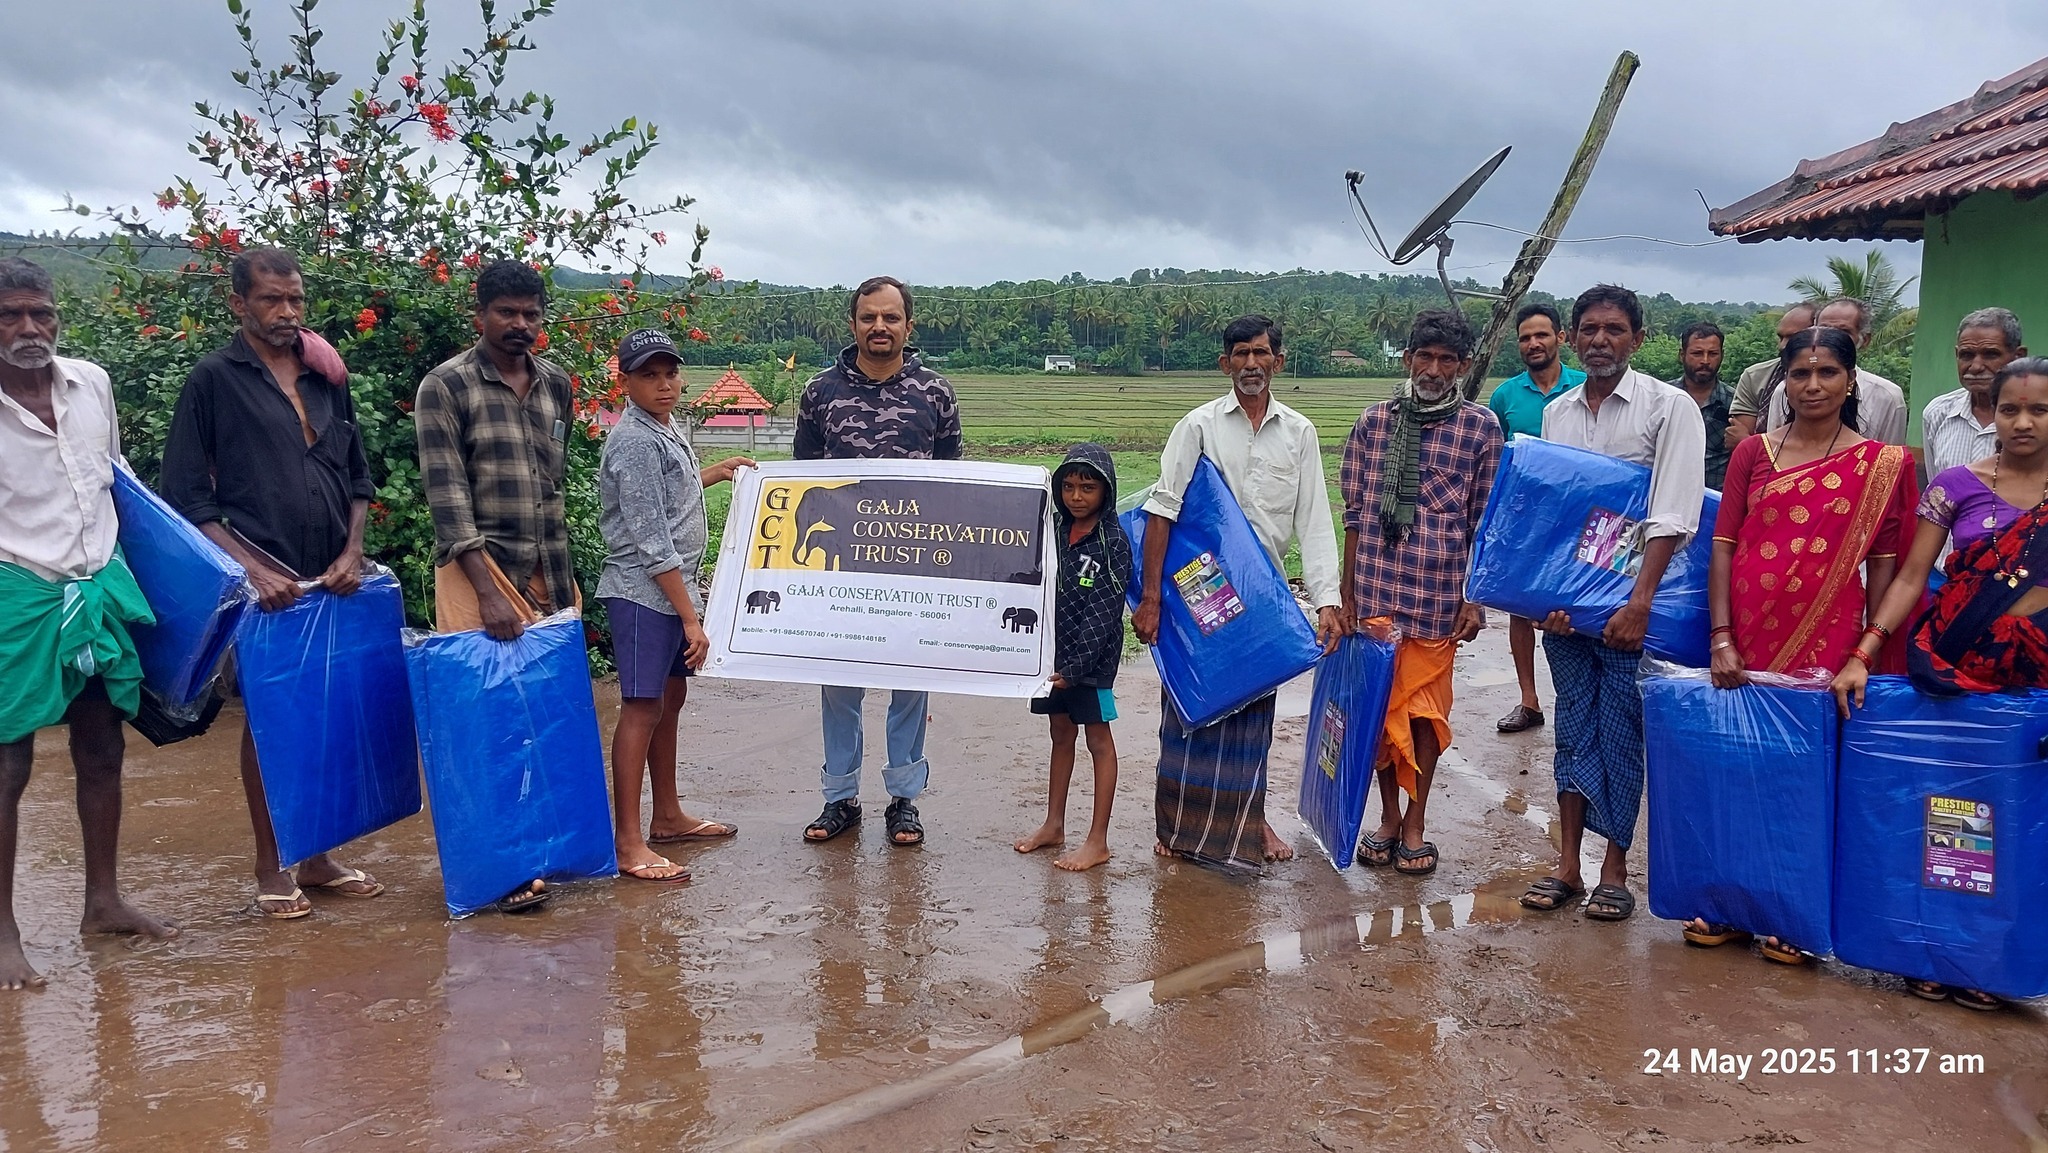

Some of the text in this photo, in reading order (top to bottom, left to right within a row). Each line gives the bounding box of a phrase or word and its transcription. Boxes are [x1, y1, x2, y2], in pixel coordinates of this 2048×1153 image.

[630, 336, 671, 351] ENFIELD
[632, 329, 666, 342] ROYAL
[856, 499, 920, 516] GAJA
[852, 520, 1031, 547] CONSERVATION
[850, 544, 927, 564] TRUST
[1173, 558, 1202, 582] PRESTIGE
[786, 583, 825, 598] GAJA
[828, 586, 933, 605] CONSERVATION
[937, 593, 982, 609] TRUST
[829, 604, 866, 615] Arehalli,
[868, 606, 913, 618] Bangalore
[920, 610, 951, 620] 560061
[943, 641, 1031, 654] conservegaja@gmail.com
[1930, 797, 1976, 812] PRESTIGE
